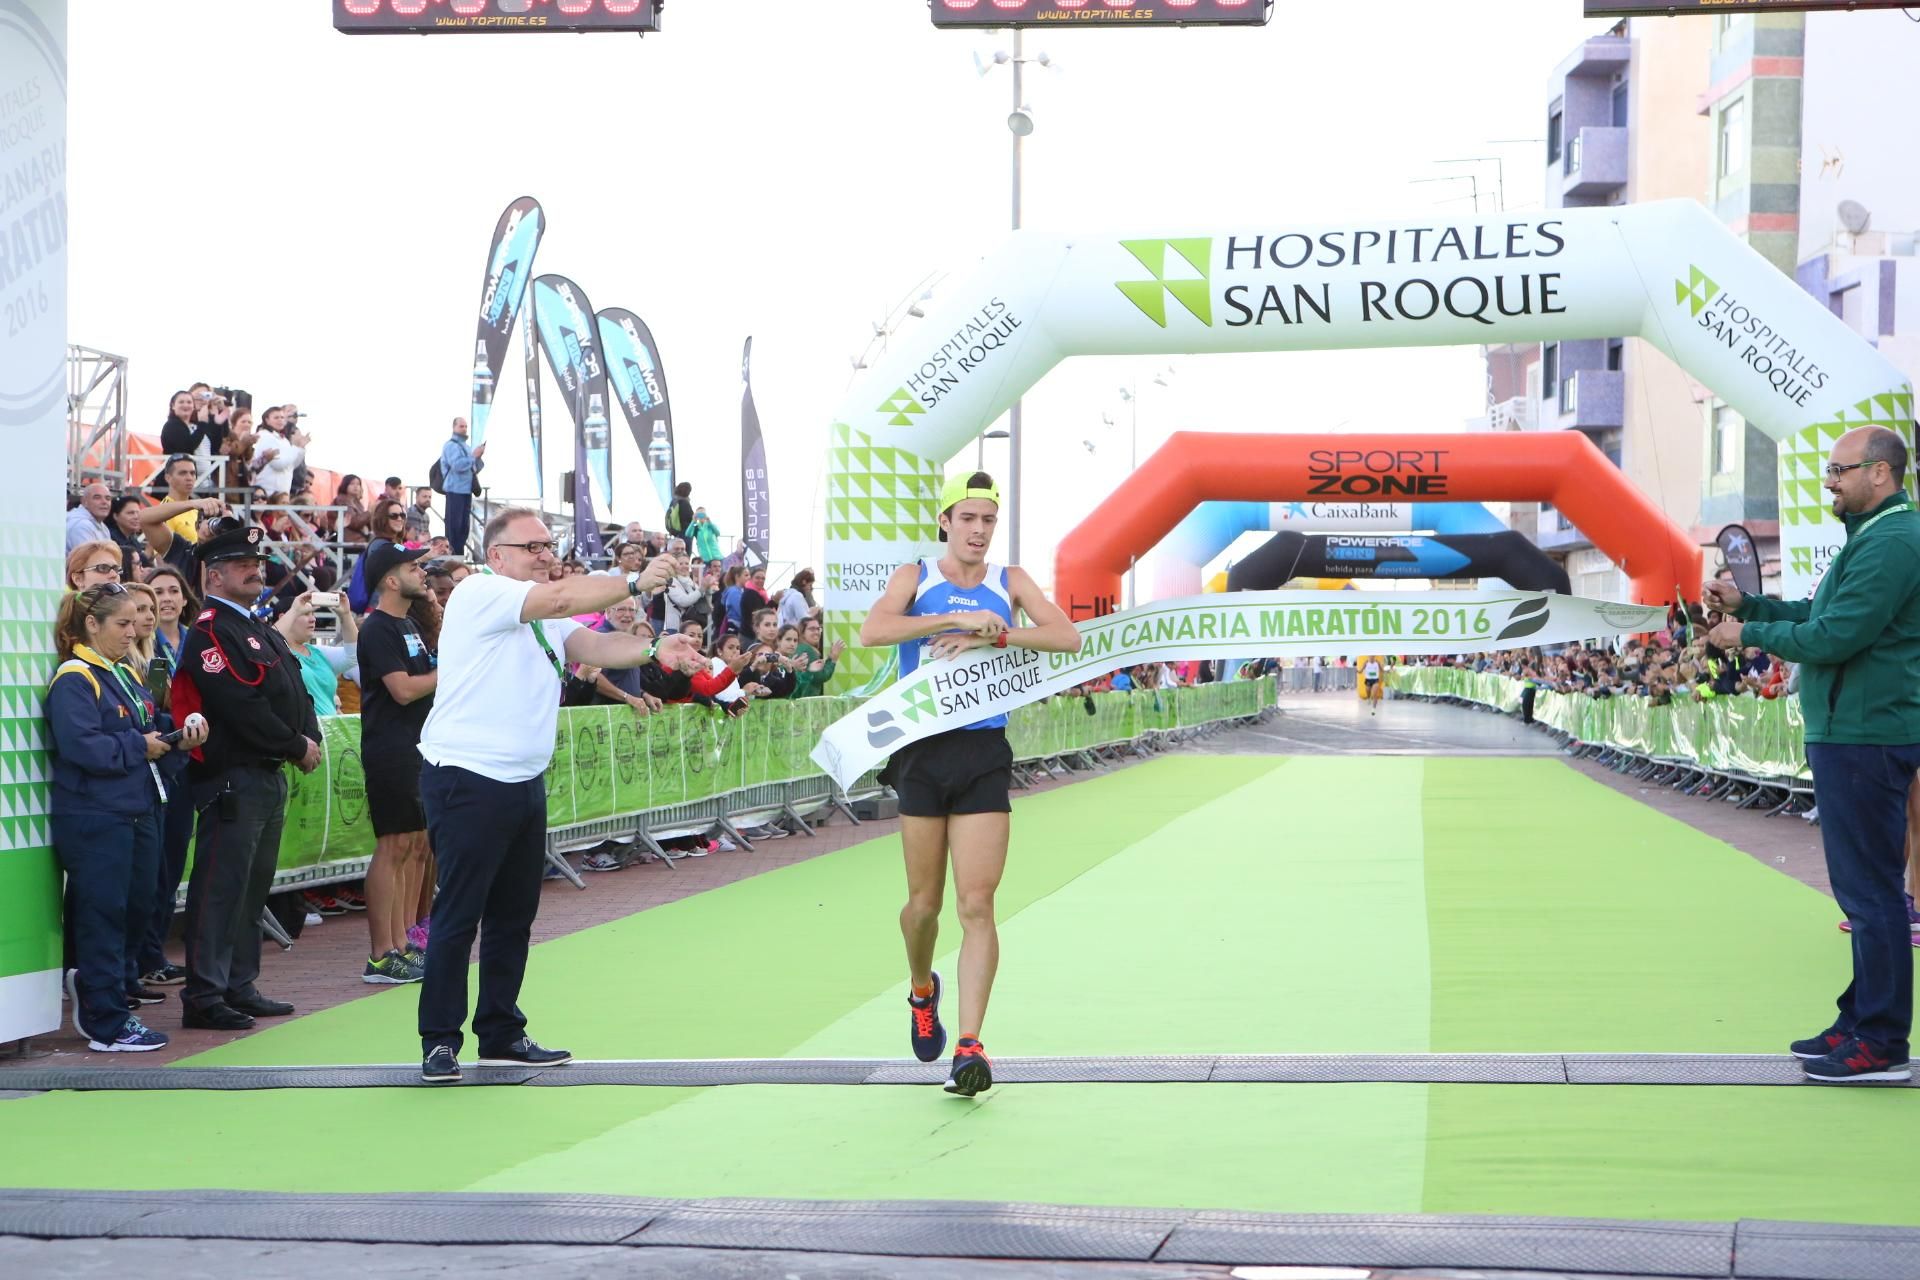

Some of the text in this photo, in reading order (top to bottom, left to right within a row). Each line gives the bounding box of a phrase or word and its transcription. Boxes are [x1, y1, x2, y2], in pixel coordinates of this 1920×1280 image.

[1225, 221, 1566, 270] HOSPITALES
[5, 280, 48, 338] 2016
[1224, 273, 1567, 326] SAN ROQUE
[907, 297, 1005, 392] HOSPITALES
[921, 312, 1022, 408] SAN ROQUE
[1698, 311, 1812, 407] SAN ROQUE
[1715, 293, 1829, 389] HOSPITALES
[1307, 475, 1448, 495] ZONE
[1308, 450, 1449, 473] SPORT
[1312, 502, 1398, 519] CaixaBank
[1326, 536, 1424, 547] POWERADE
[843, 563, 899, 576] HOSPIT
[843, 579, 870, 591] SAN
[1325, 565, 1353, 573] bebida
[934, 647, 1039, 692] HOSPITALES
[1121, 611, 1250, 648] CANARIA
[1260, 604, 1402, 637] MARATÓN
[1412, 608, 1491, 635] 2016
[941, 666, 1042, 715] SAN ROQUE
